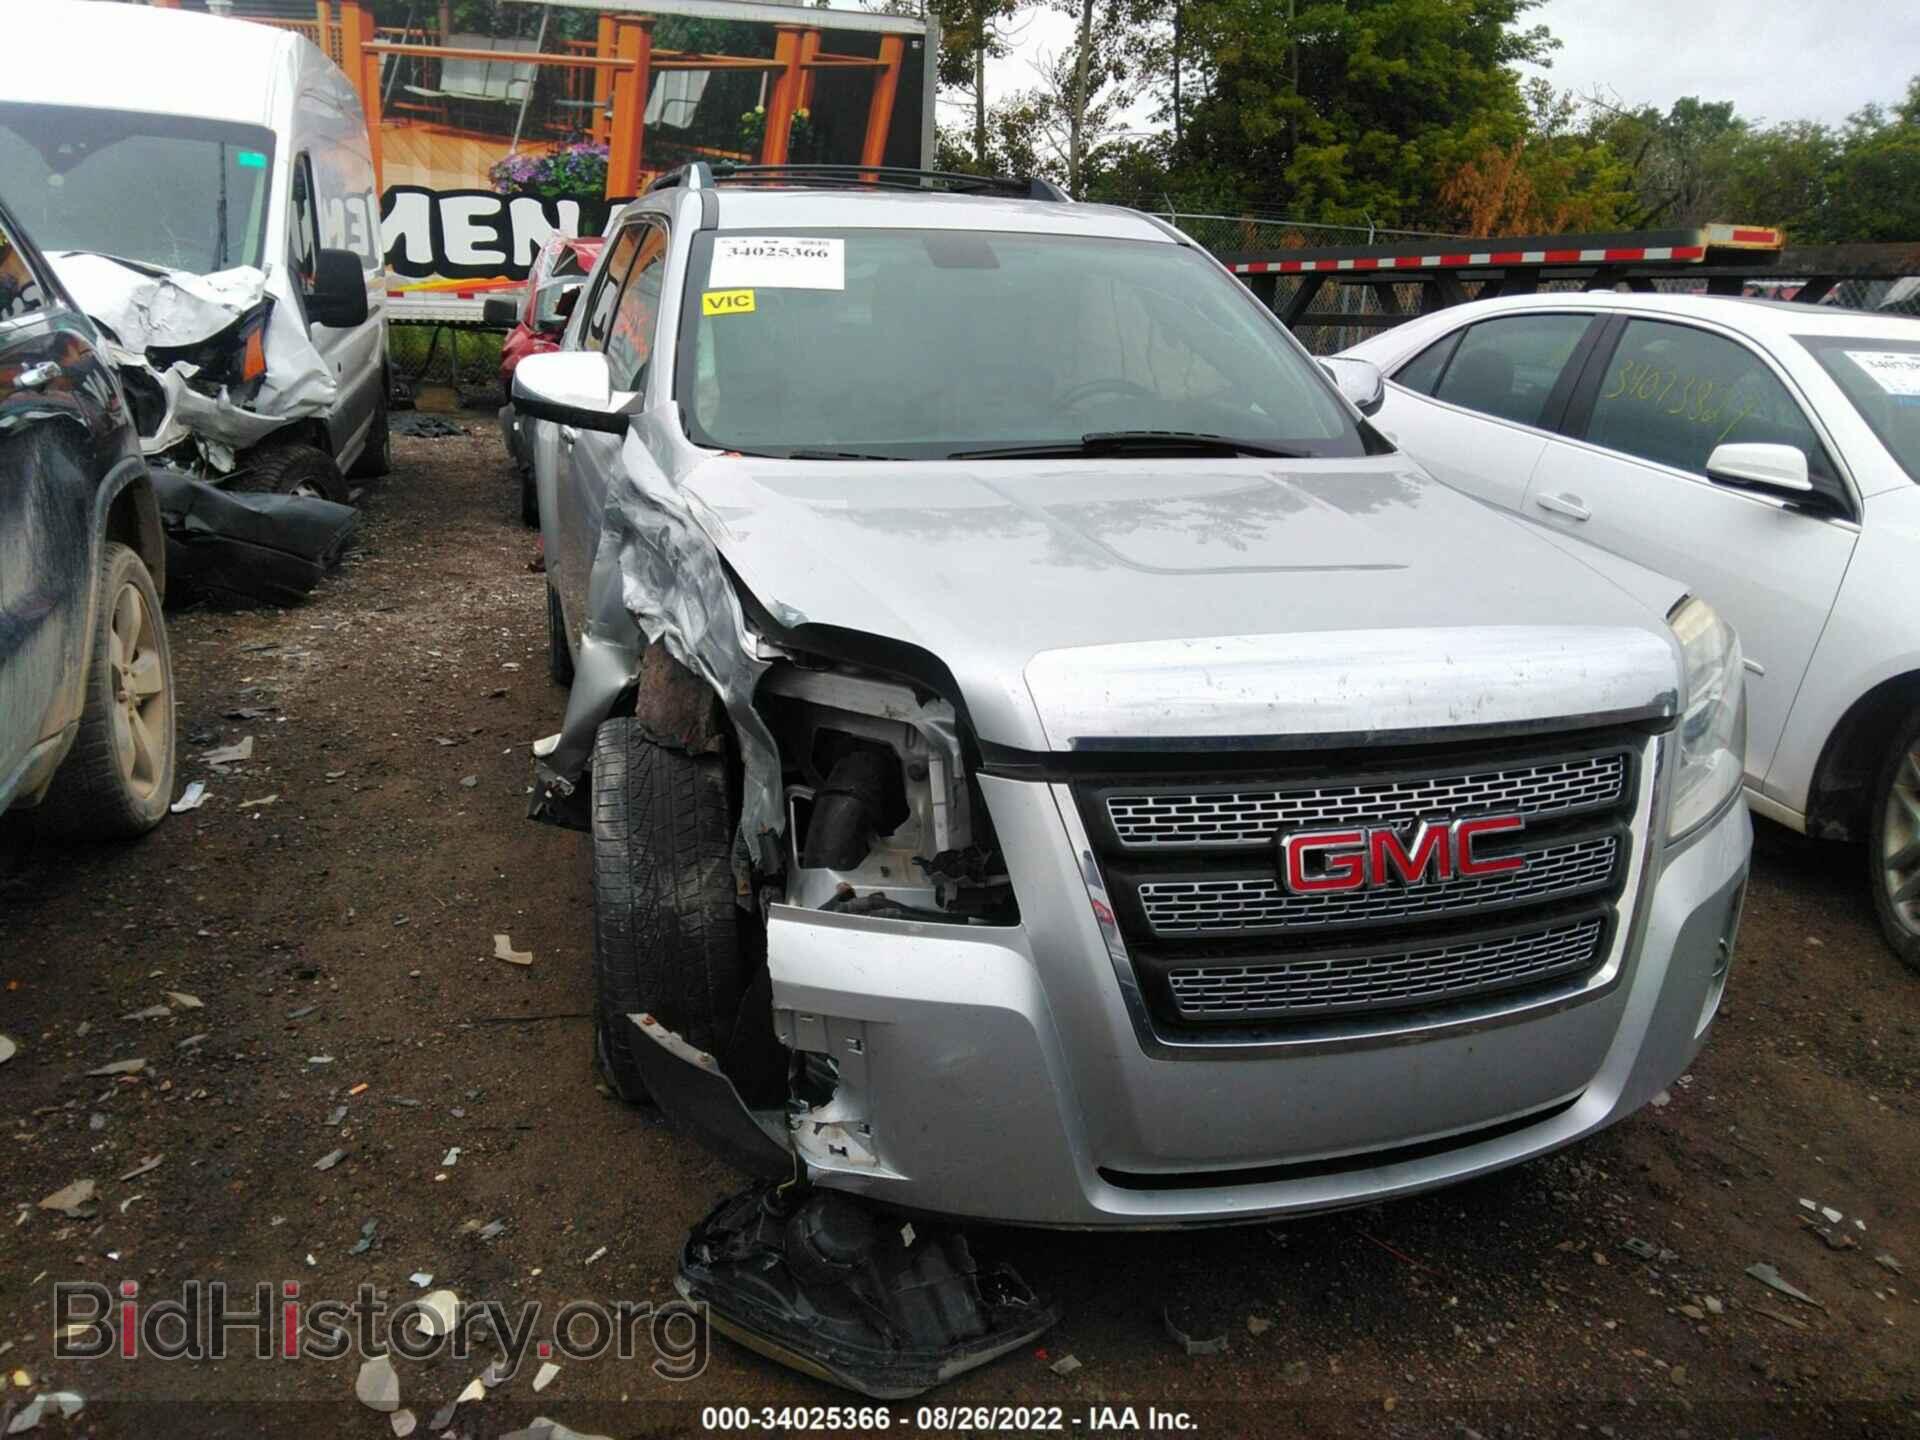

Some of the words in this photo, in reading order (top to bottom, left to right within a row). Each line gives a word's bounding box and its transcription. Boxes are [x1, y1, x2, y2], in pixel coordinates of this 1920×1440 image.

[727, 247, 829, 259] 34025366
[707, 295, 751, 309] VIC
[1282, 814, 1527, 895] GMC
